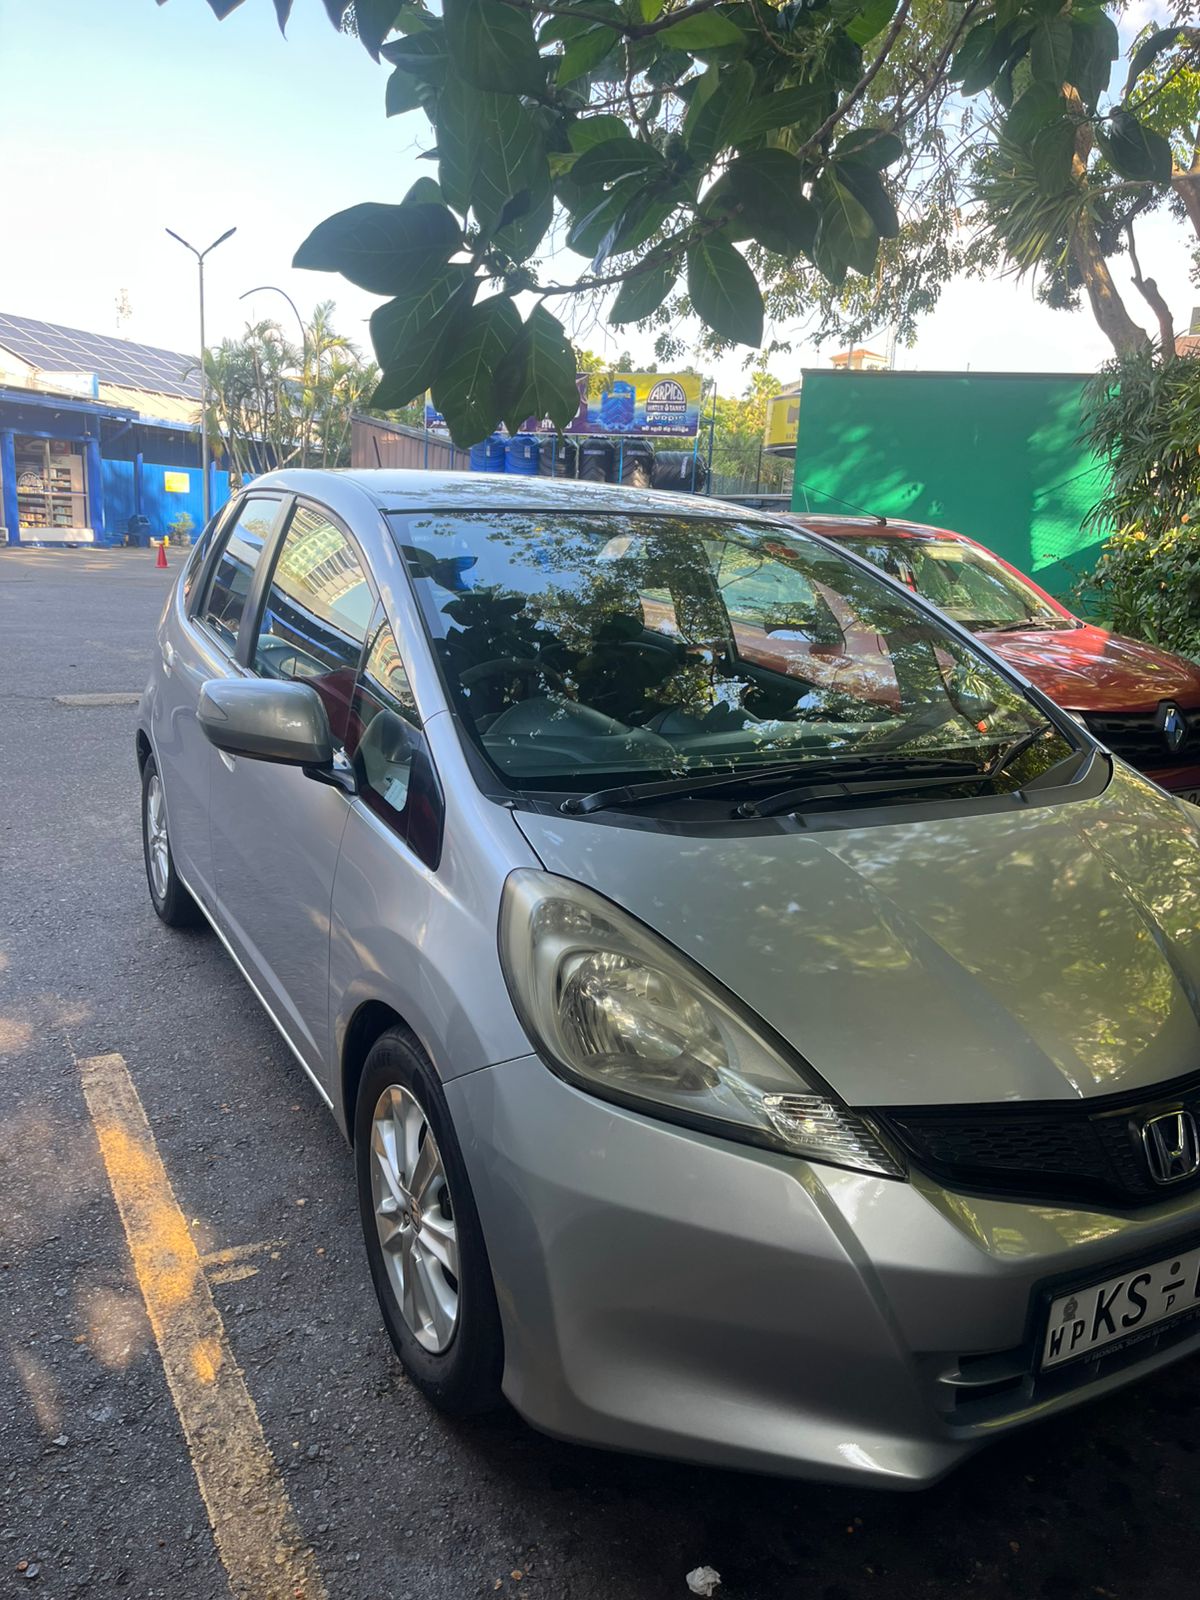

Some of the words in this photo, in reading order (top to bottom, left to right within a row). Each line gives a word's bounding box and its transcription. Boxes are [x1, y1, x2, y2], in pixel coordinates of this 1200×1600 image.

[651, 383, 683, 401] ARPICO
[647, 404, 664, 412] WATER
[669, 404, 686, 412] TANKS
[1165, 1293, 1176, 1312] P
[1049, 1319, 1086, 1358] WP
